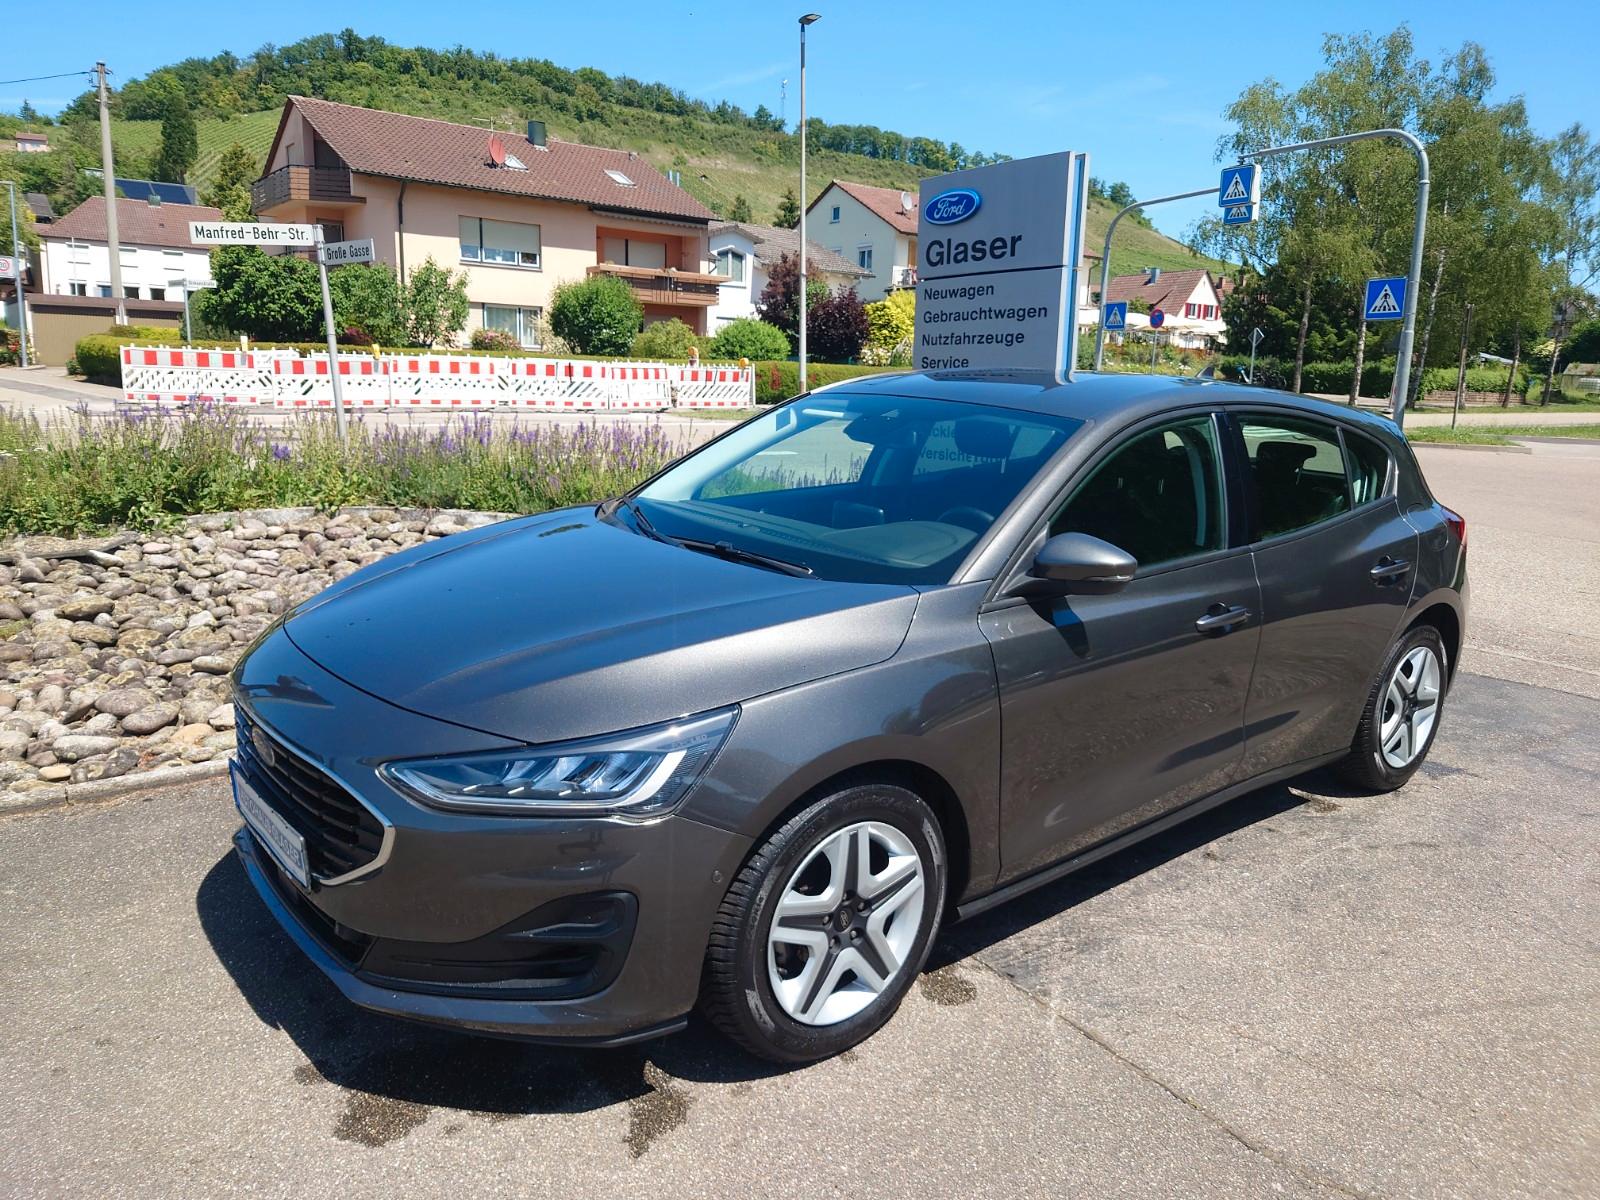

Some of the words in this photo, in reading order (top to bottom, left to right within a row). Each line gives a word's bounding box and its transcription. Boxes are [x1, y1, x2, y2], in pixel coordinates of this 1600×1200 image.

[933, 196, 967, 219] Ford
[194, 225, 309, 241] Manfred-Behr-Str.
[326, 247, 347, 261] Große
[349, 245, 370, 257] Gasse
[925, 234, 1023, 267] Glaser
[923, 284, 995, 300] Neuwagen
[923, 306, 1048, 324] Gebrauchtwagen
[921, 332, 1025, 347] Nutzfahrzeuge
[921, 356, 969, 369] Service
